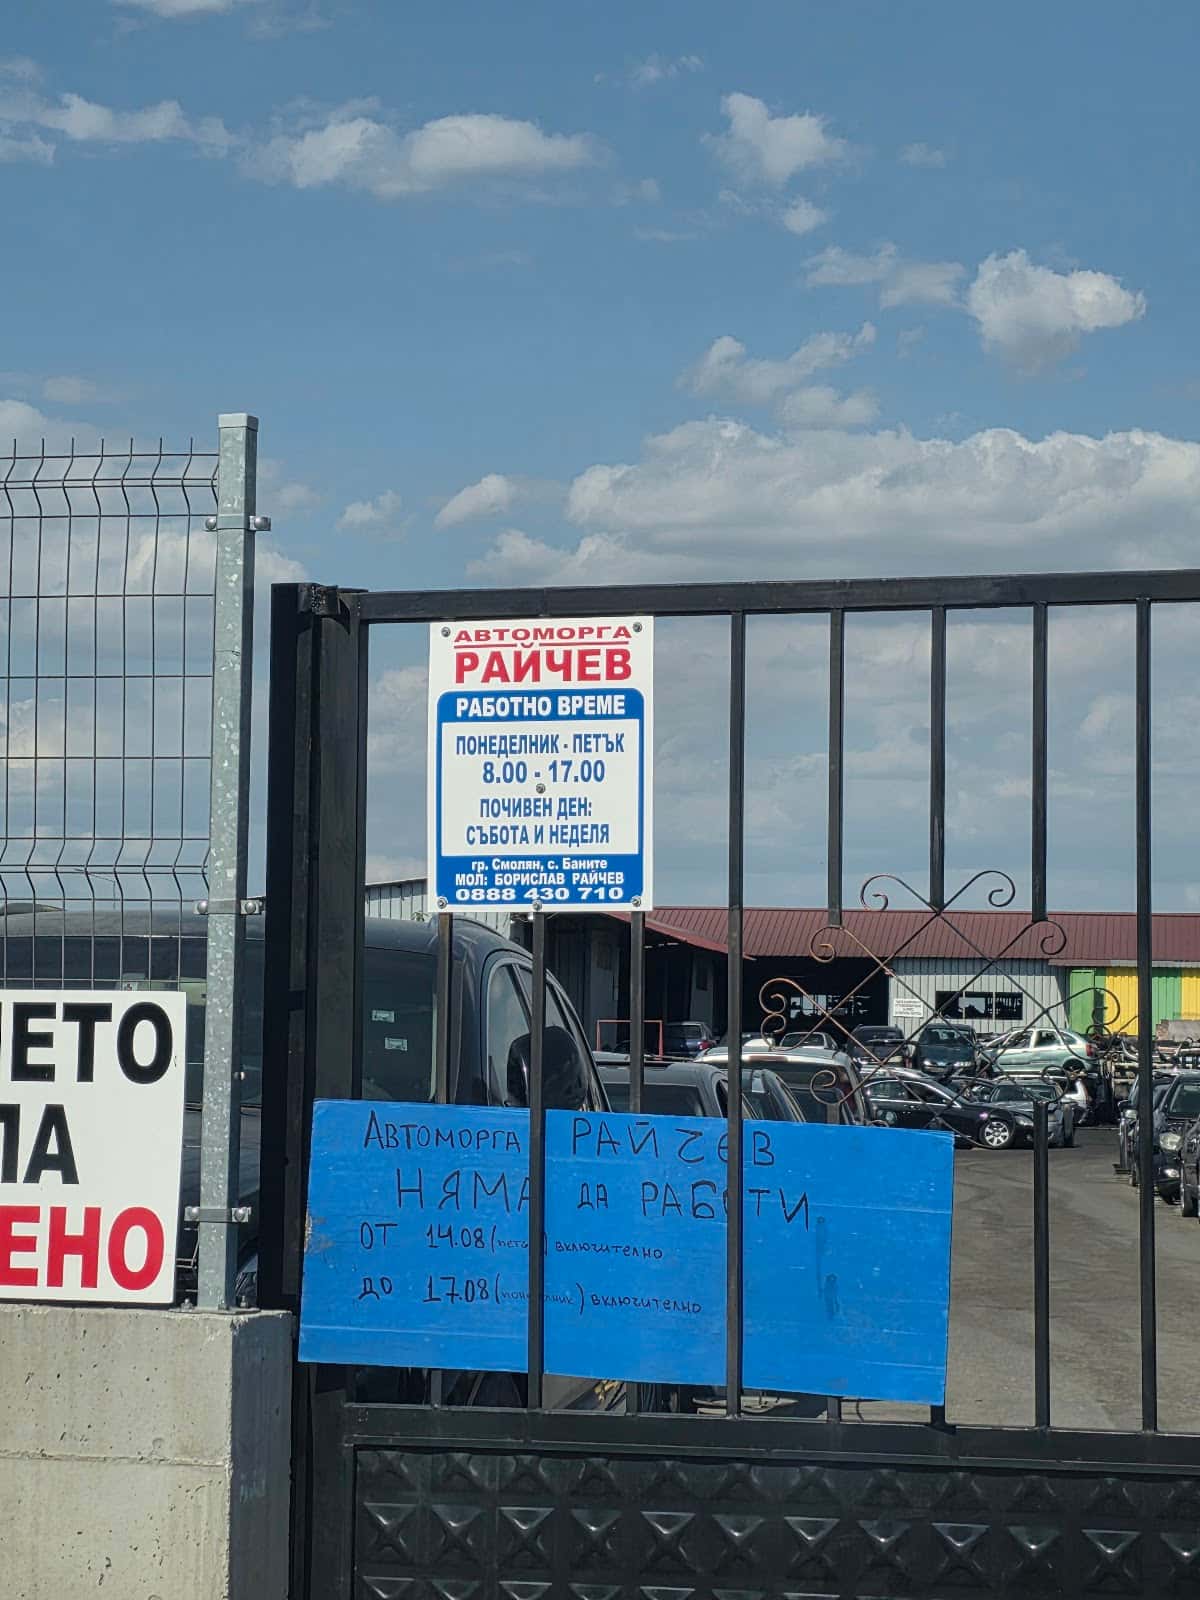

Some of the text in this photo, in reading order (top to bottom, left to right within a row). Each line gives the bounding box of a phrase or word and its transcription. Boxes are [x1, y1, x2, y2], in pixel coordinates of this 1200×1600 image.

[454, 626, 632, 643] АВТОМОРГА
[455, 642, 632, 684] РАЙЧЕВ
[456, 694, 625, 717] РАБОТНО ВРЕМЕ
[456, 734, 560, 758] ПОНЕДЕЛНИК
[573, 733, 625, 753] ПЕТЪК
[482, 761, 528, 784] 8.00
[548, 760, 606, 783] 17.00
[480, 797, 593, 820] ПОЧИВЕН ДЕН:
[466, 823, 610, 847] СЪБОТА И НЕДЕЛЯ
[471, 857, 608, 873] гр. Смолян, с. Баните
[455, 869, 625, 886] МОЛ: БОРИСЛАВ РАЙЧЕВ
[455, 887, 624, 901] 0888 430 710
[0, 1001, 173, 1084] ЕТО
[641, 1180, 809, 1232] РАБТИ
